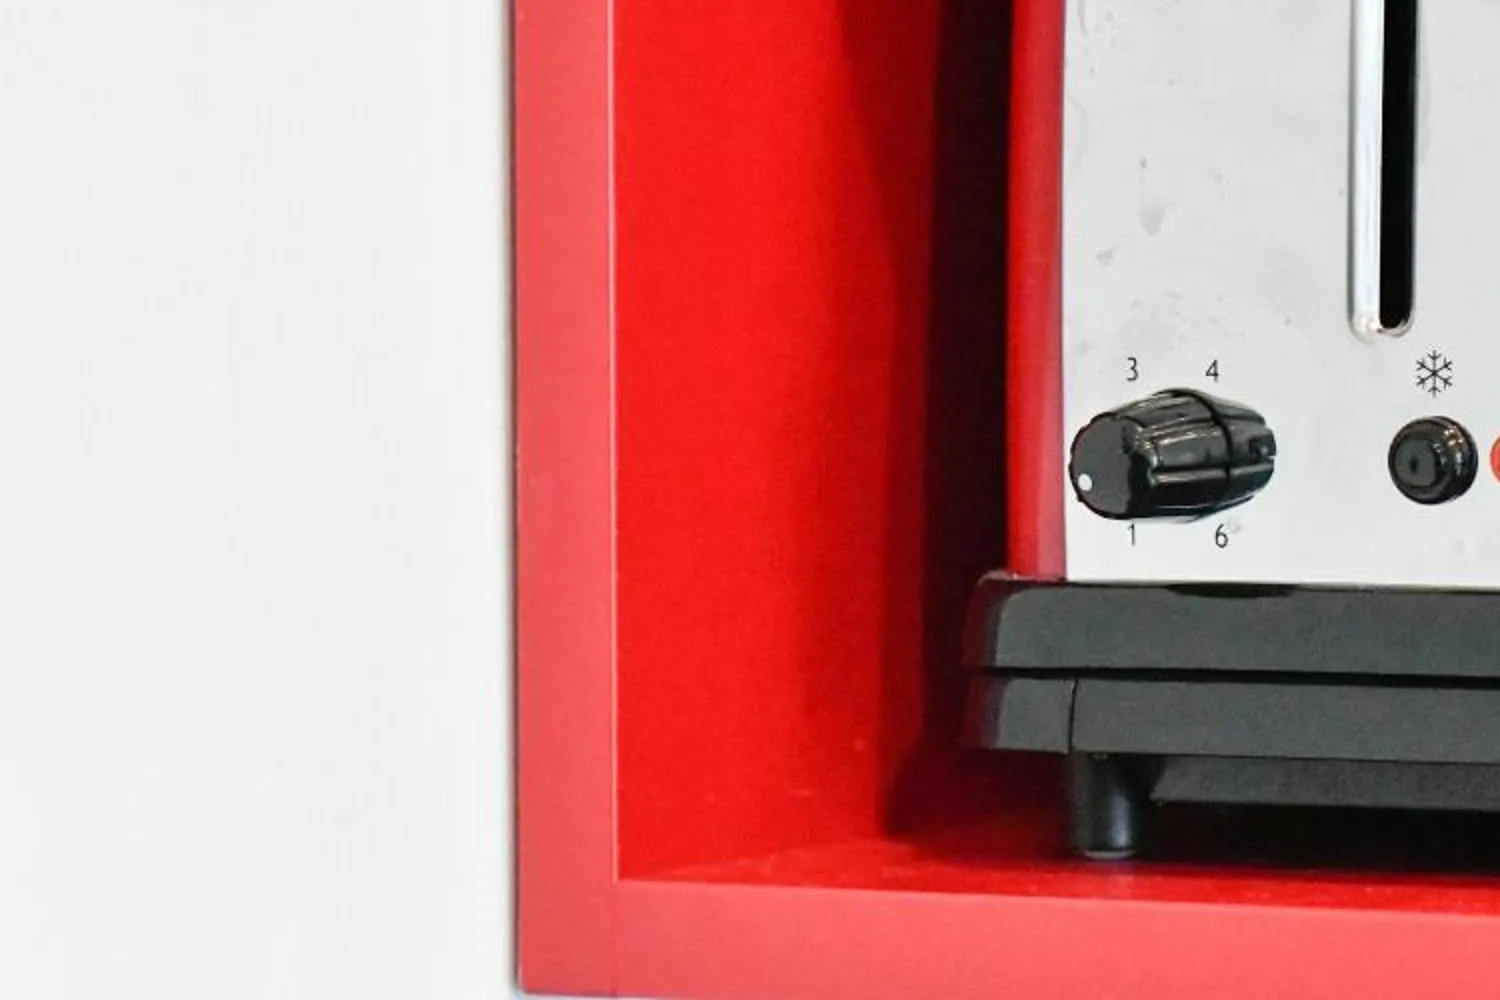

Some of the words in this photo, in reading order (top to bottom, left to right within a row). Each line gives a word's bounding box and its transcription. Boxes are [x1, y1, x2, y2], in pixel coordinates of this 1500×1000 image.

[1126, 357, 1139, 382] 3
[1205, 359, 1220, 383] 4
[1128, 523, 1136, 546] 1
[1215, 523, 1229, 548] 6
